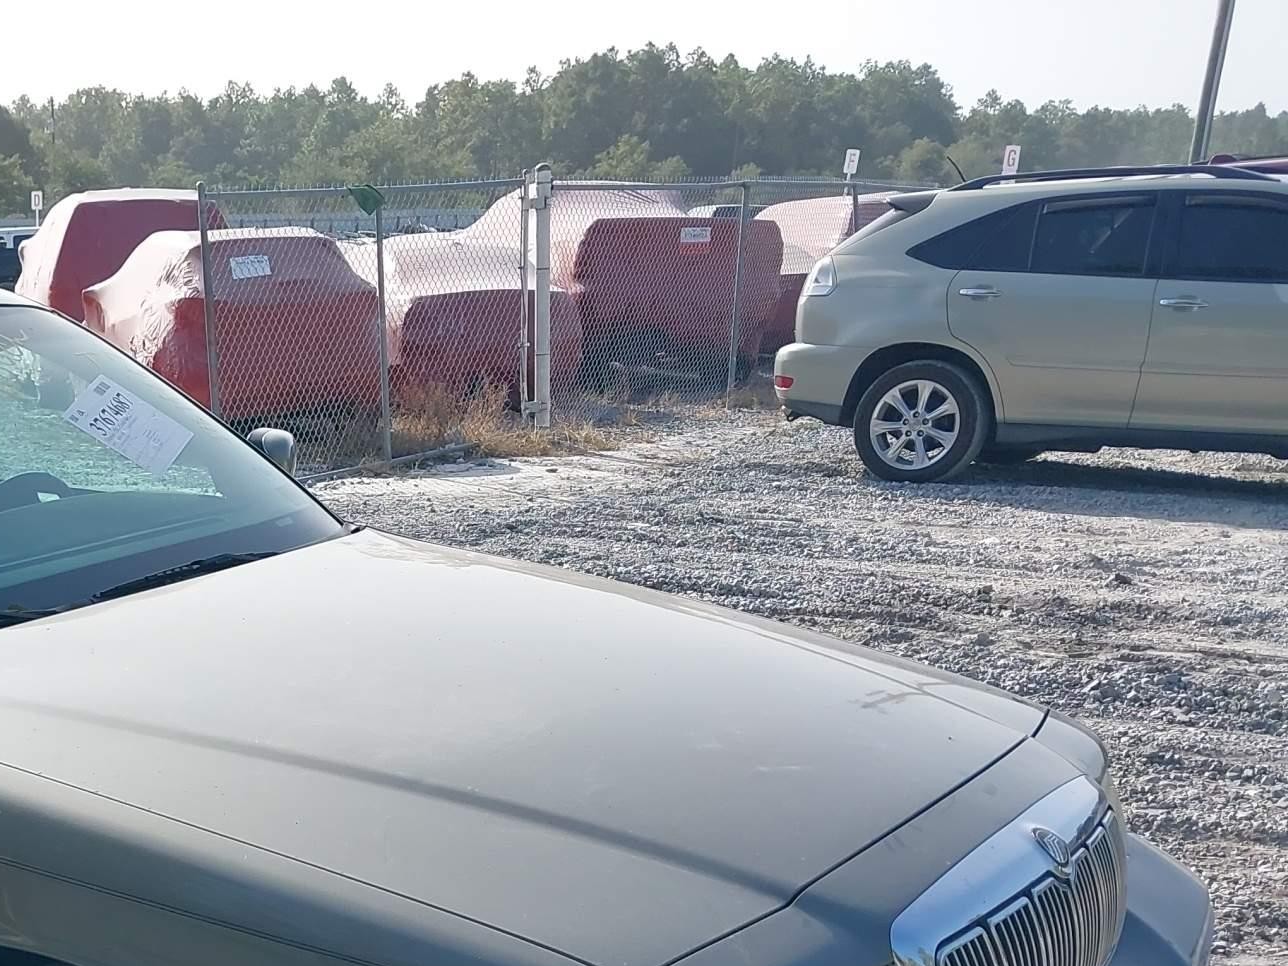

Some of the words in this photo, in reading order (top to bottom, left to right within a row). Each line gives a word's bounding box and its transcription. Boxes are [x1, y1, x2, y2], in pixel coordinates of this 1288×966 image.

[847, 152, 857, 169] F
[1007, 149, 1017, 168] G
[89, 392, 134, 436] 37674687
